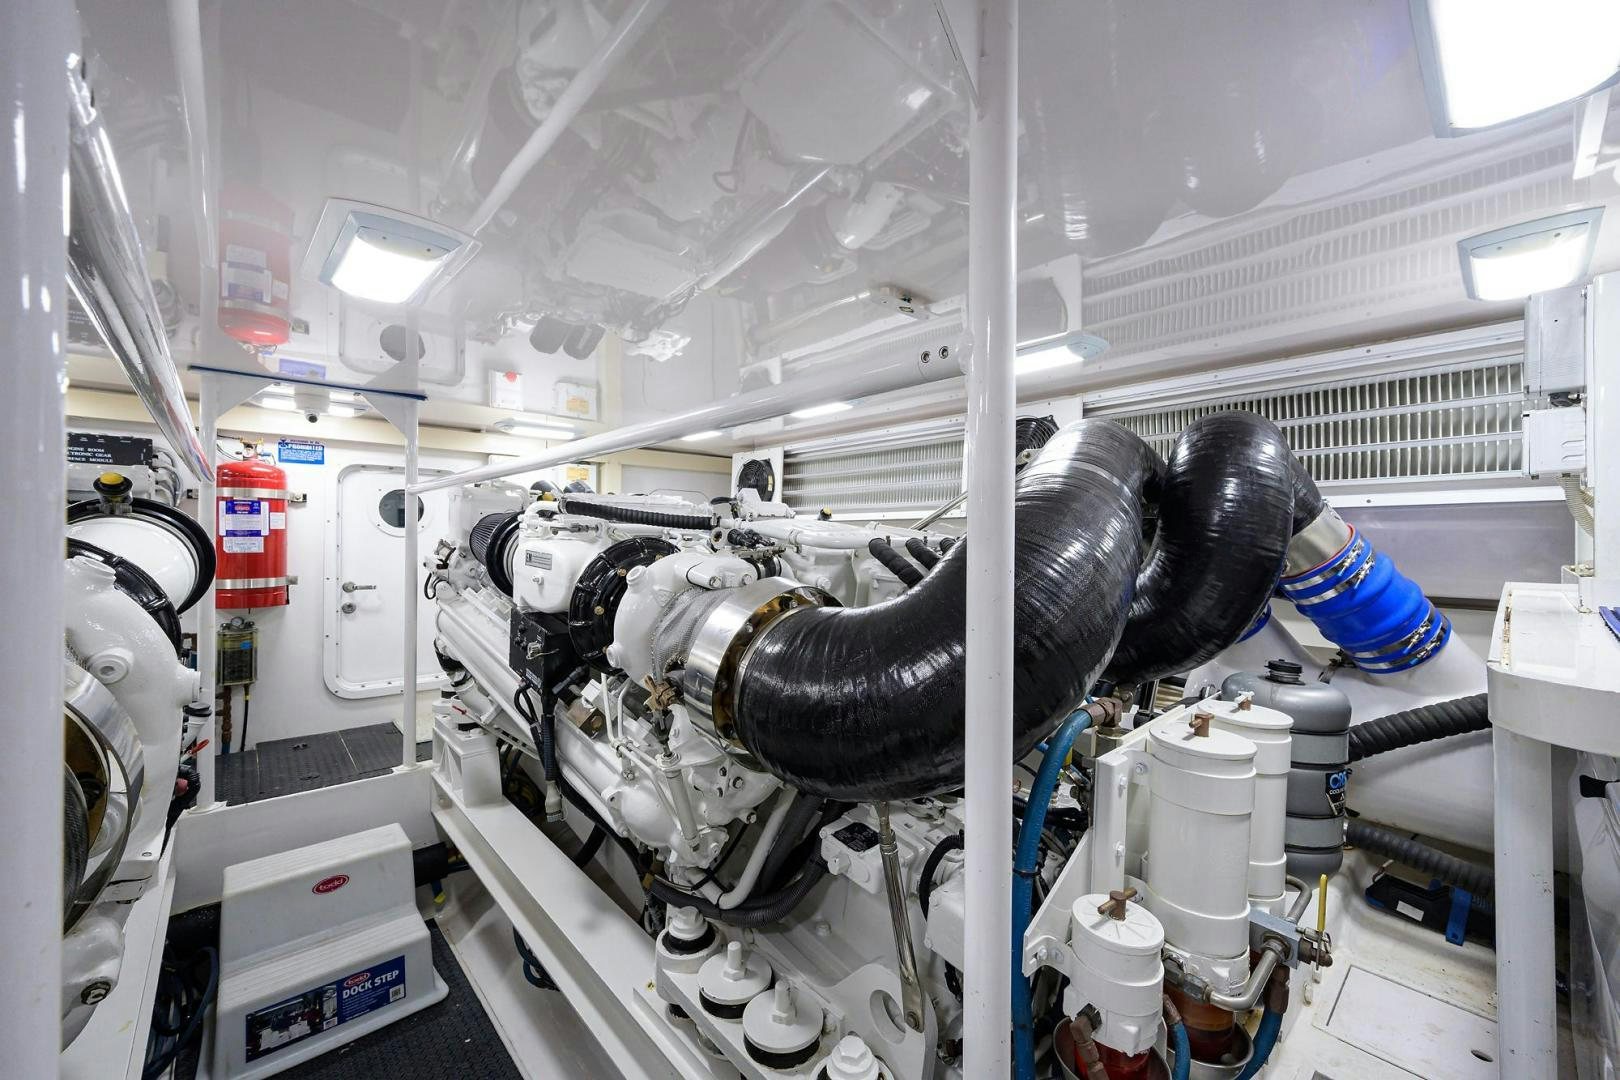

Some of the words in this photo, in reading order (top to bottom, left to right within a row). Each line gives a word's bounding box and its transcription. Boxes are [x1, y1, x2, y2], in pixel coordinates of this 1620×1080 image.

[318, 877, 343, 891] todd
[342, 980, 372, 999] DOCK
[374, 970, 399, 987] STEP
